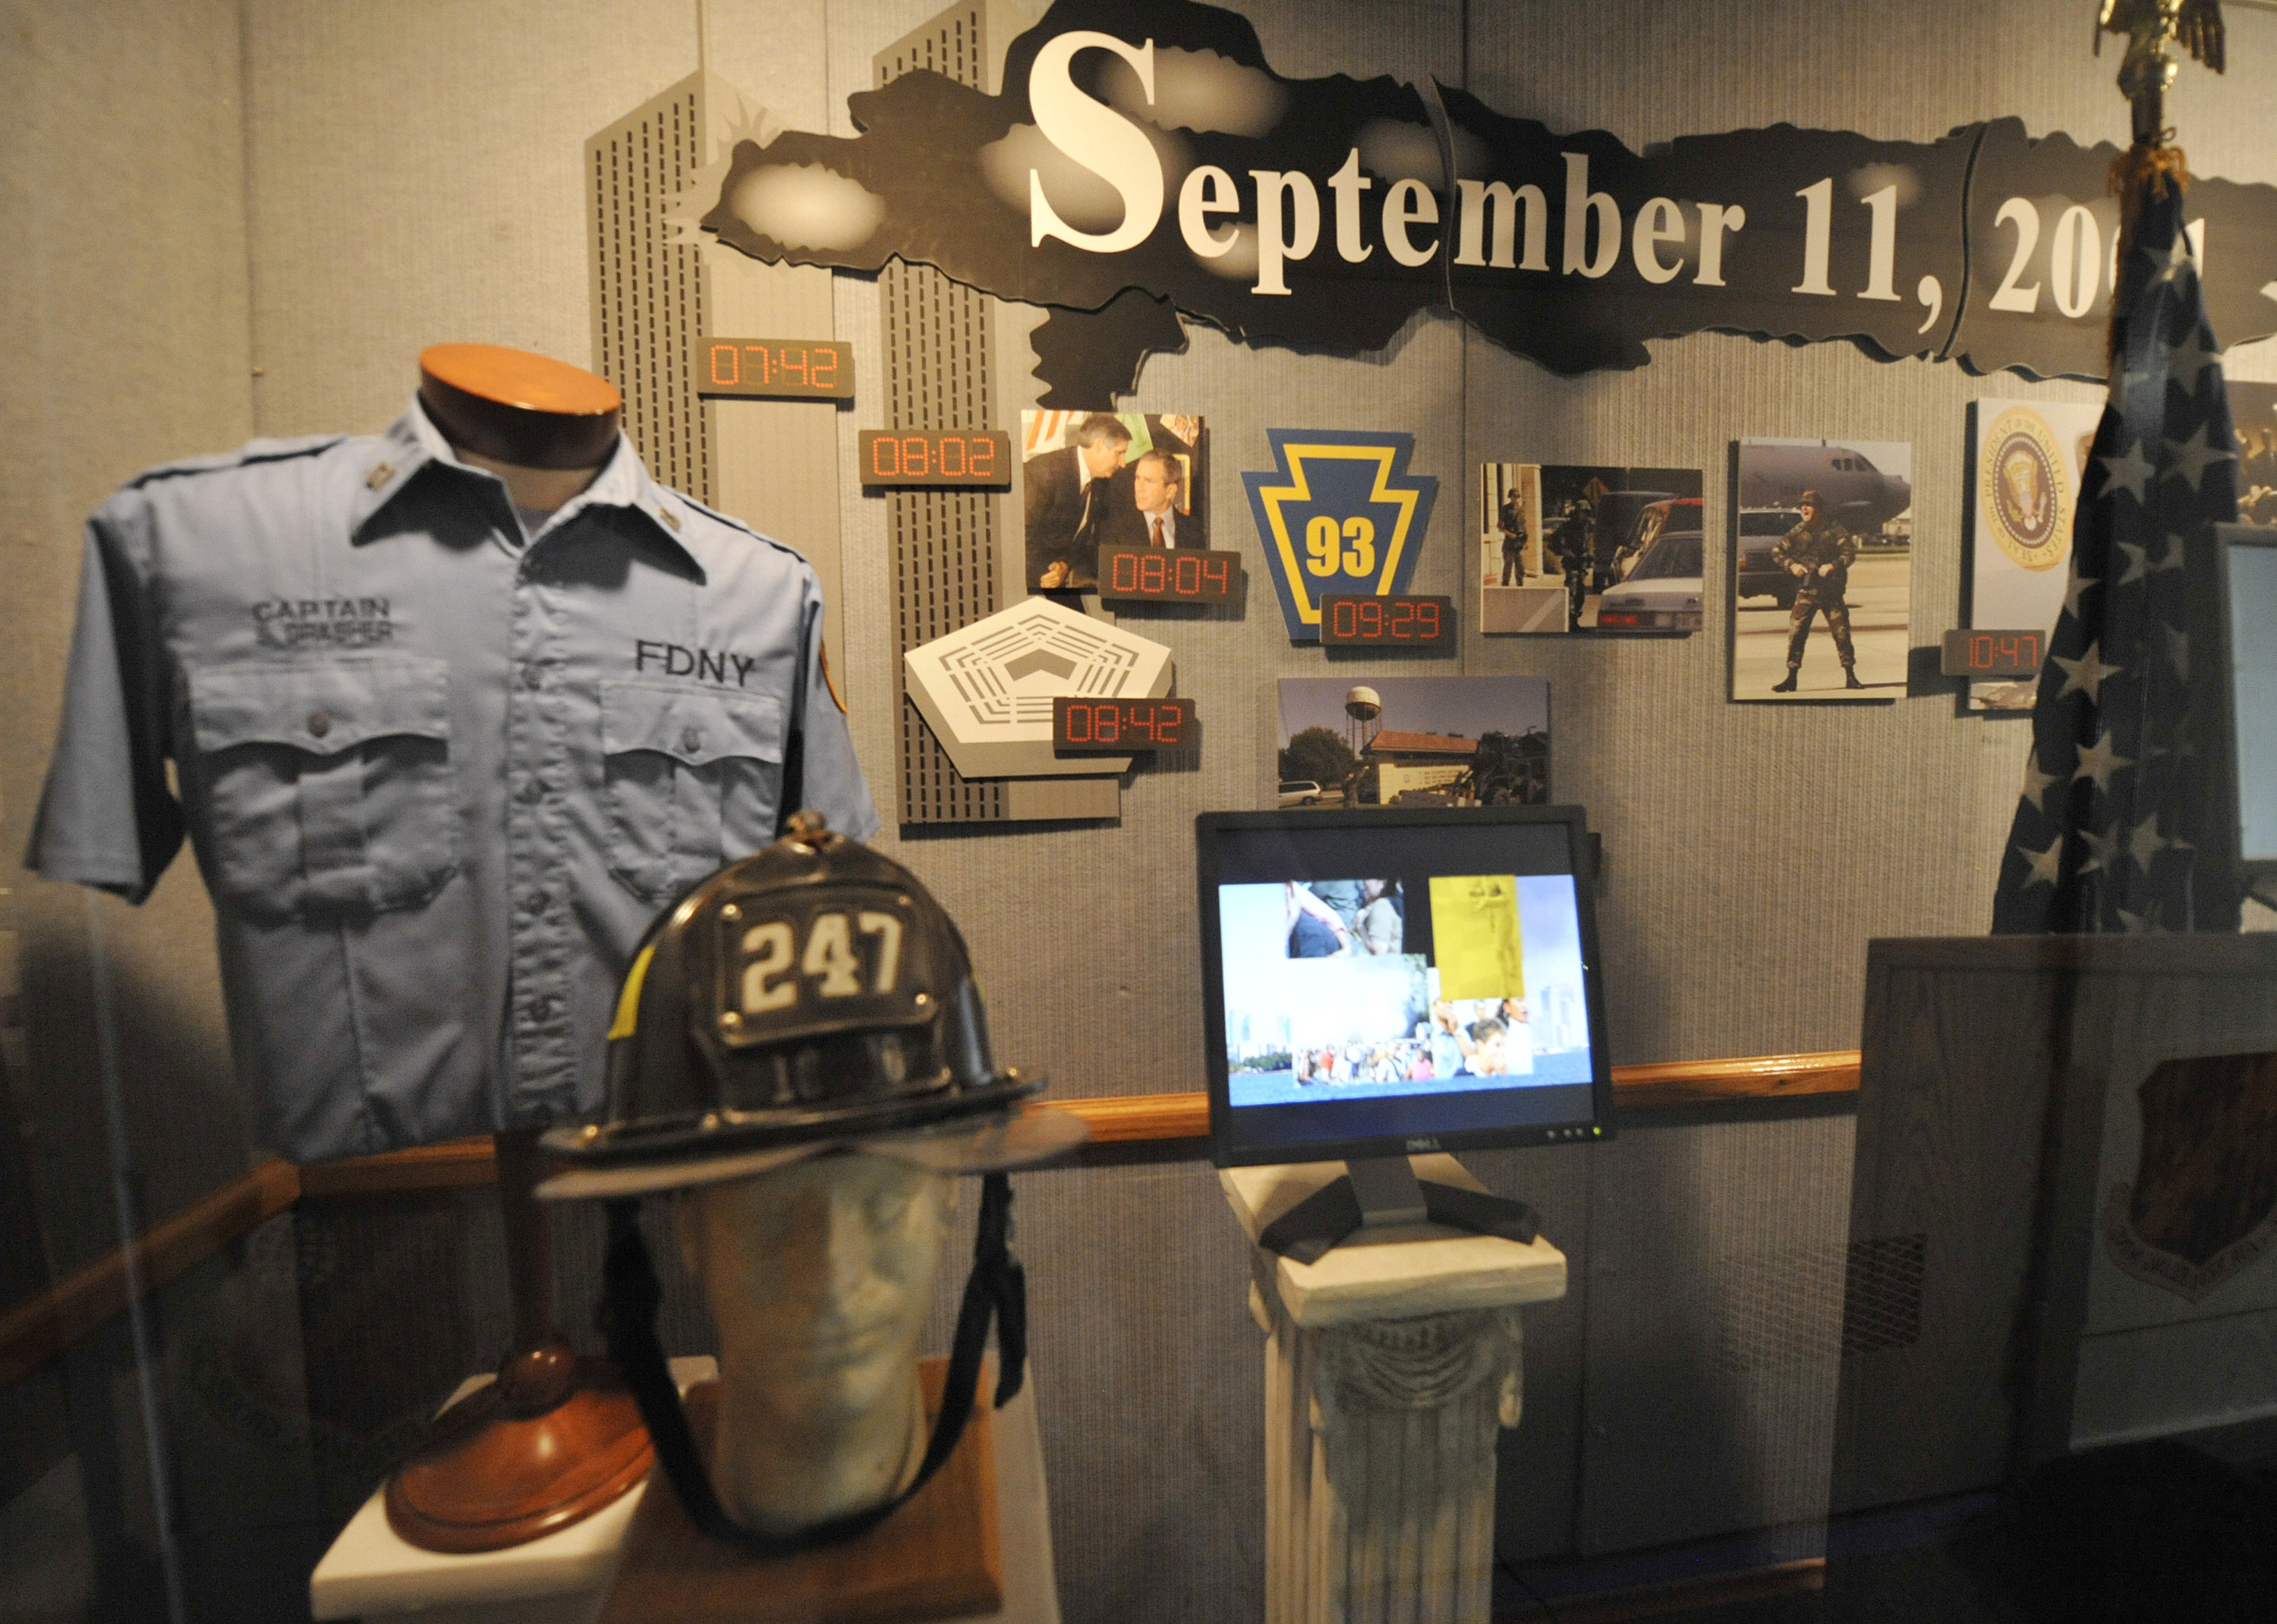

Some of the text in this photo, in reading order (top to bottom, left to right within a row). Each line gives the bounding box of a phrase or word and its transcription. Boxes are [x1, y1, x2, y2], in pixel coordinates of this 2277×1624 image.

[1028, 30, 2205, 335] September 11, 20
[710, 344, 838, 389] 07:42
[872, 436, 995, 477] 08:02
[1306, 516, 1375, 578] 93
[1112, 553, 1227, 595] 08:04
[252, 596, 390, 622] CAPTAIN
[1334, 601, 1441, 638] 09:29
[635, 638, 757, 688] FDNY
[1968, 634, 2038, 669] 10:47
[1066, 704, 1183, 744] 08:42
[742, 911, 903, 1015] 247
